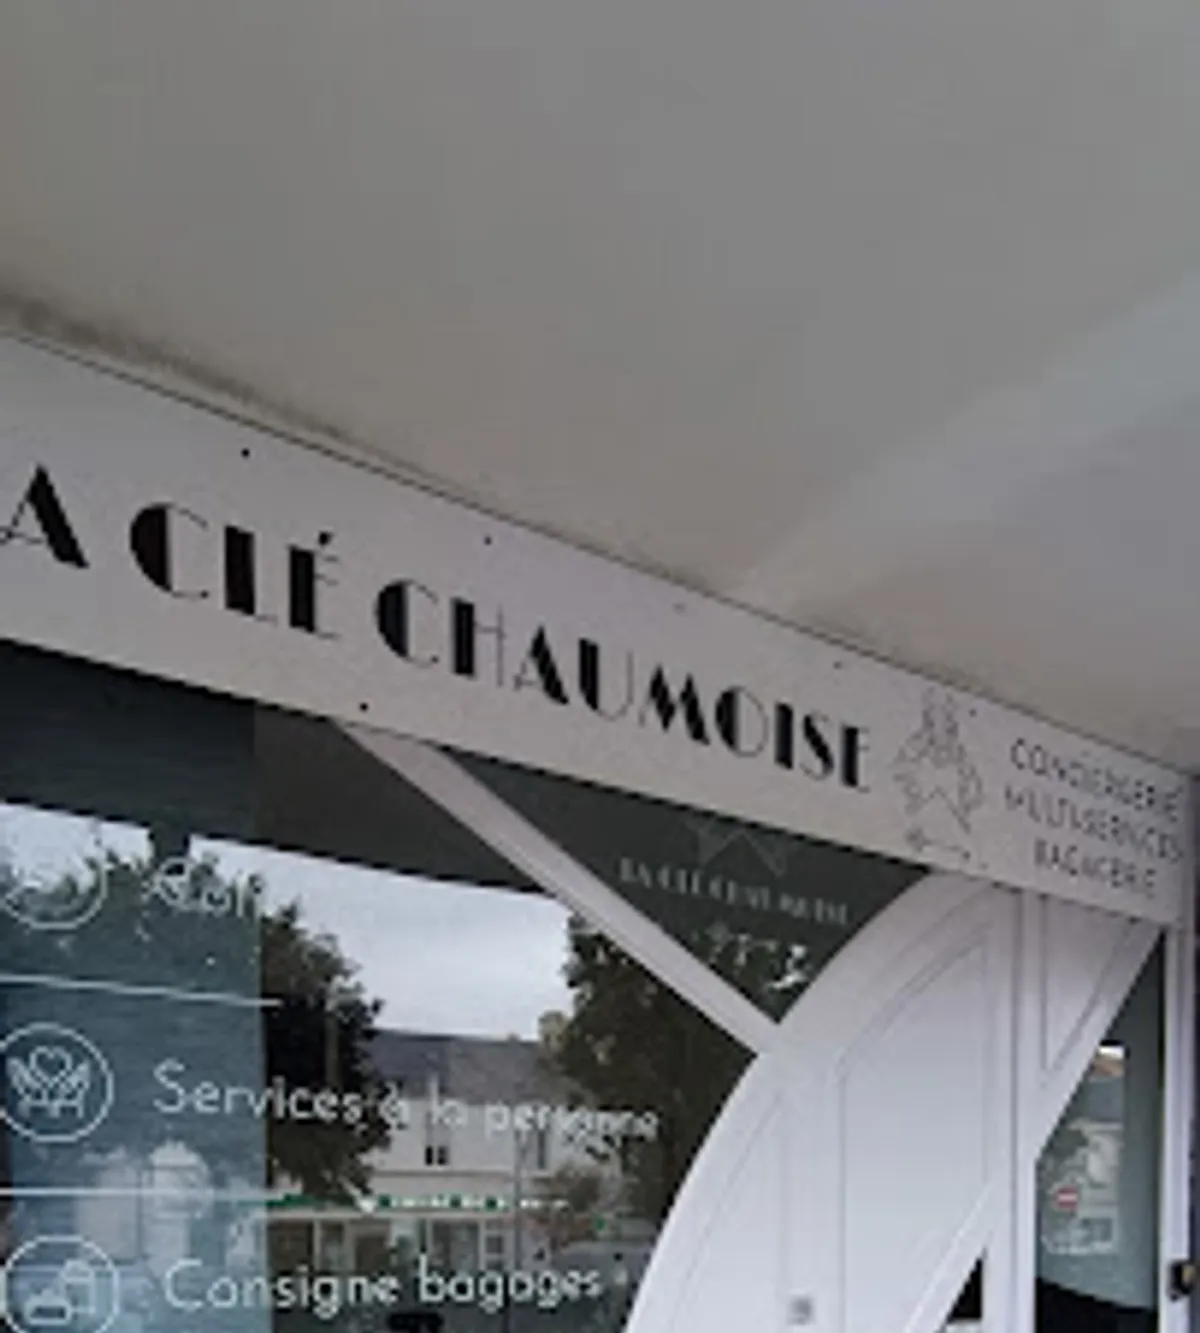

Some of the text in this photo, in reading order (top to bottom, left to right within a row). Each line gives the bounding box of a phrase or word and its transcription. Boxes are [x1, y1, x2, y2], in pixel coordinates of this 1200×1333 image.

[129, 502, 340, 639] CLÉ
[374, 578, 870, 793] CHAUMOISE
[153, 1057, 362, 1123] Services
[164, 1254, 601, 1319] Consigne bagages
